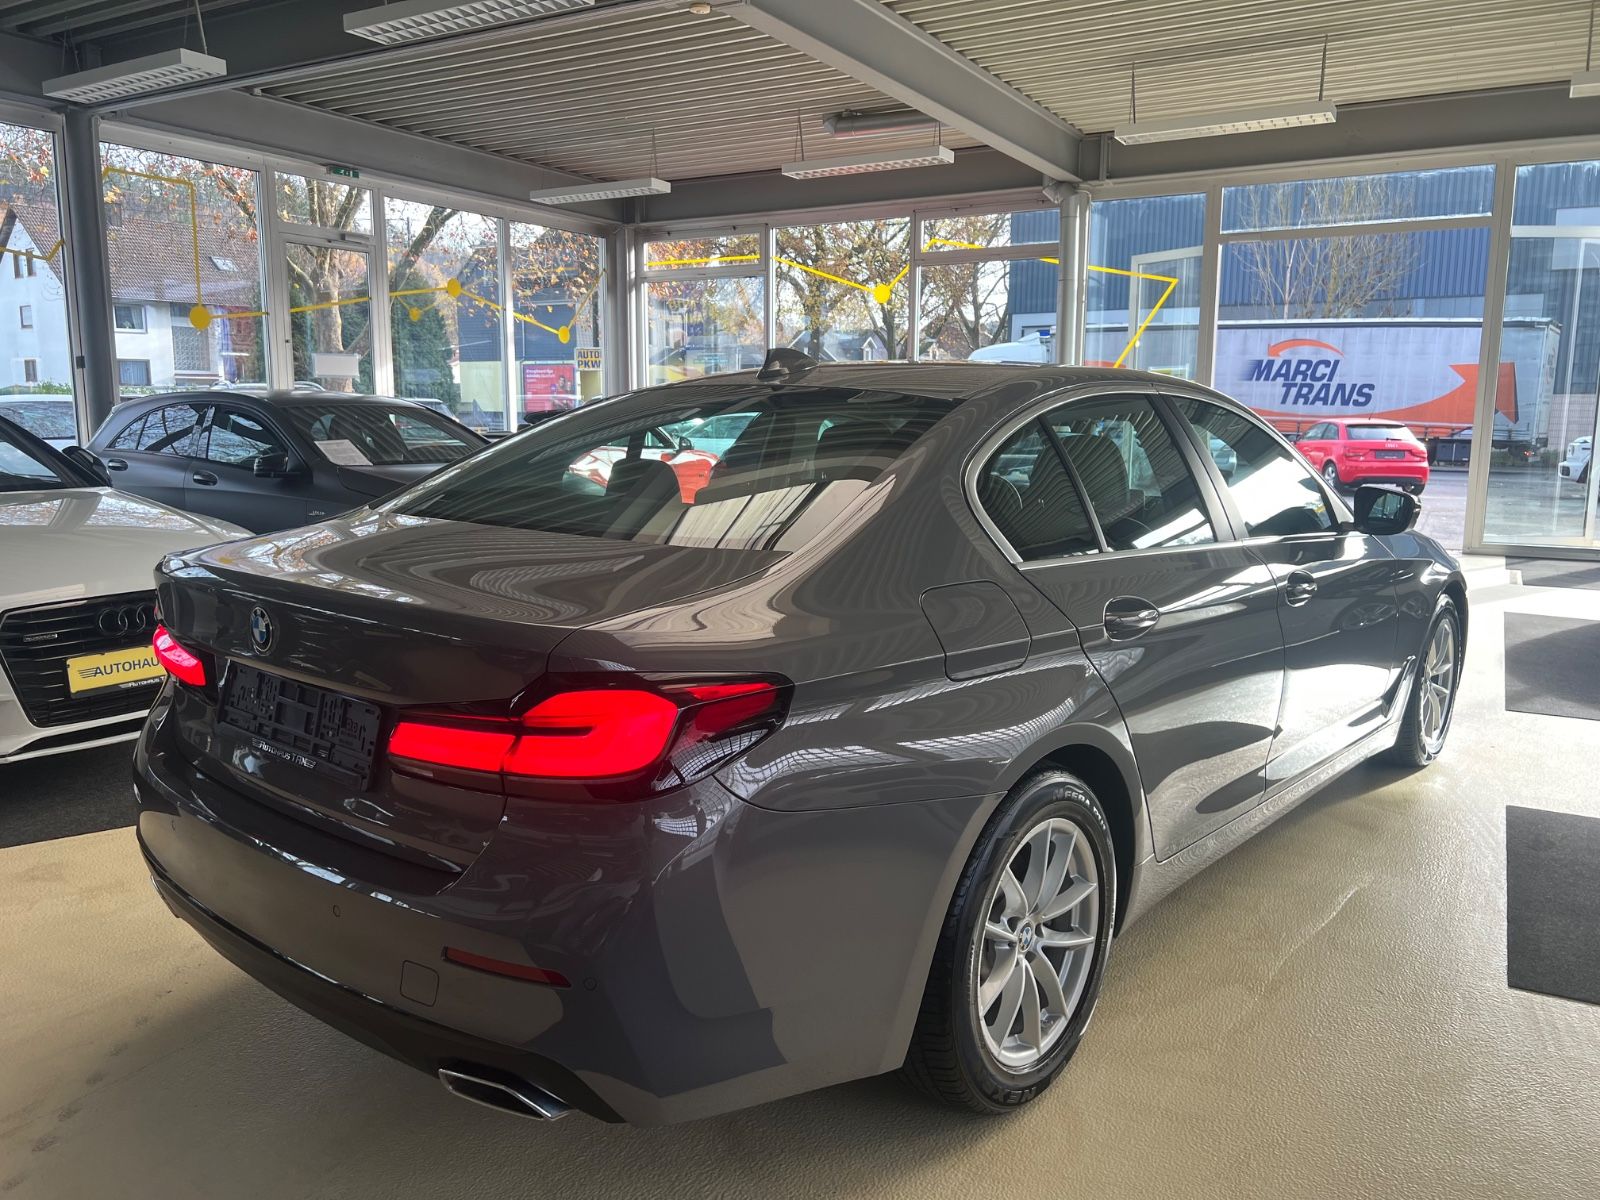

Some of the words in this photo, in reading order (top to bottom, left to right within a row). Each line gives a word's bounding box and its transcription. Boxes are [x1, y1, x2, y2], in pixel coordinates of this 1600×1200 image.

[577, 350, 600, 359] AUTO
[577, 360, 601, 369] PKW
[1249, 359, 1341, 382] MARCI
[1280, 382, 1376, 407] TRANS
[93, 656, 160, 677] AUTOHAU
